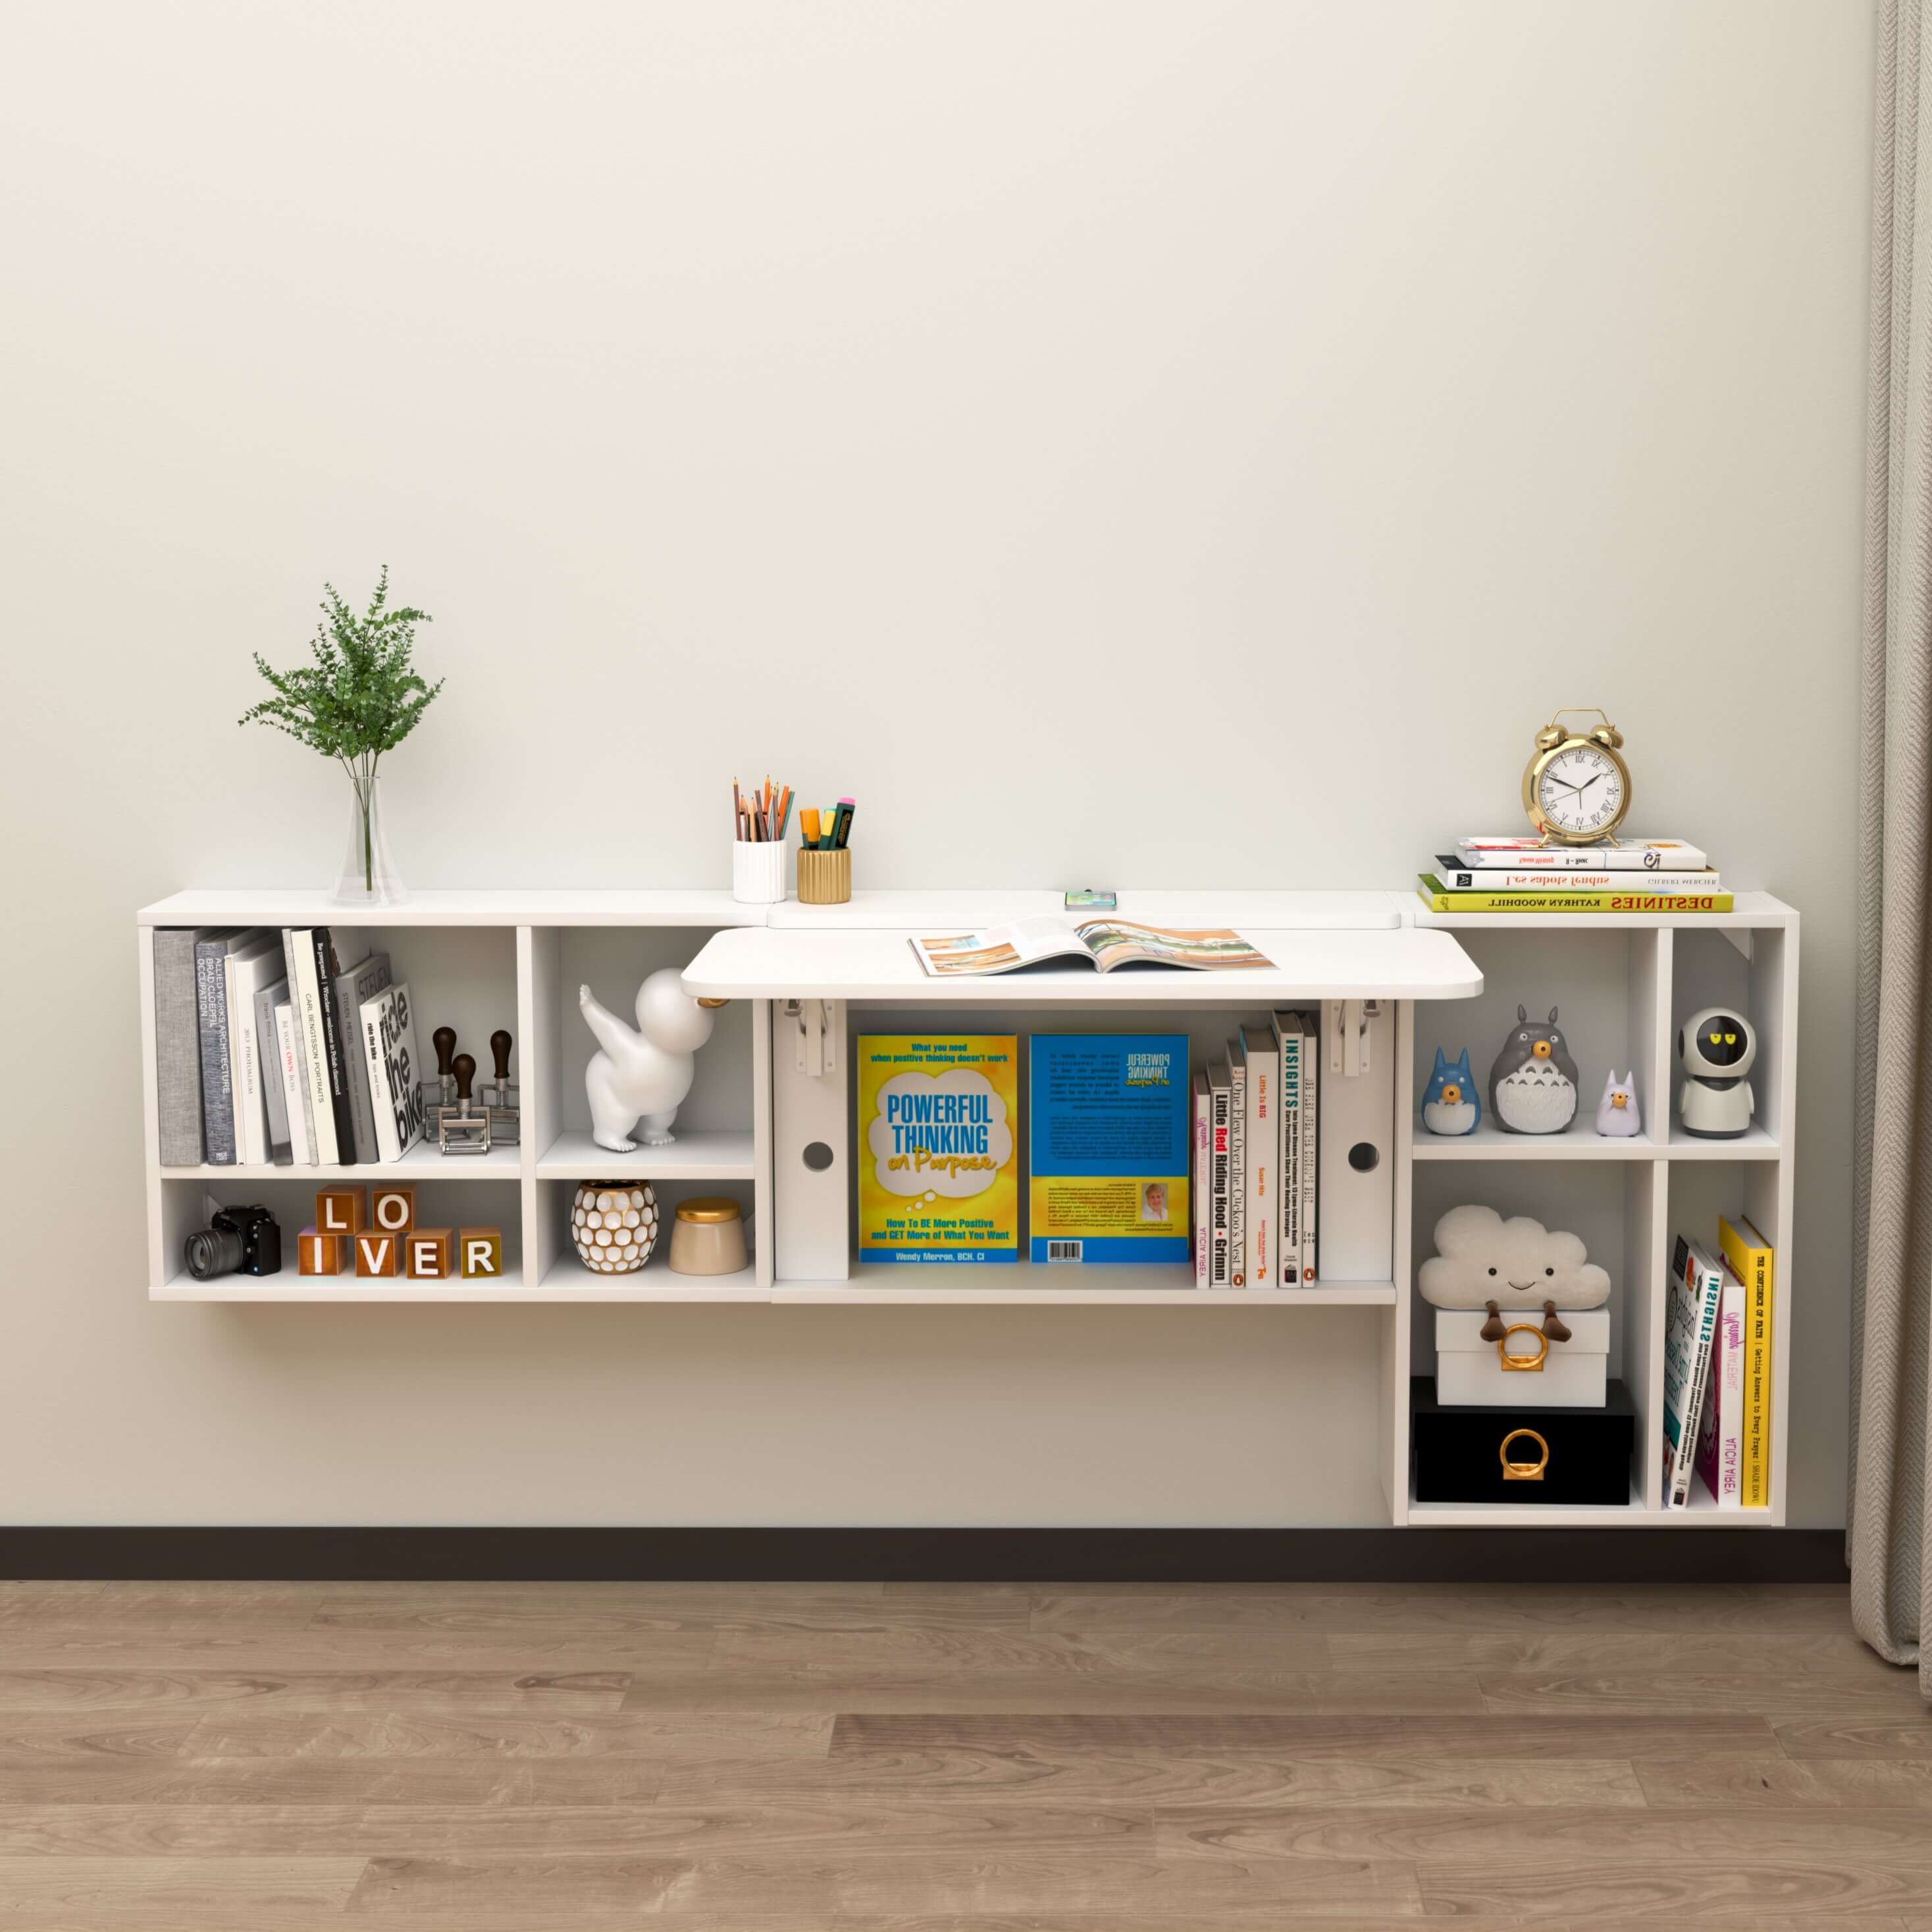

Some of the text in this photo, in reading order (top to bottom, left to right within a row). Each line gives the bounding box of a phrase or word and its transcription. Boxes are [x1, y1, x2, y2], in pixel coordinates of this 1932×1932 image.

[206, 958, 215, 983] BRAD
[215, 958, 224, 989] ALLIED
[197, 958, 207, 1017] OCCUPATION
[219, 1025, 230, 1094] ARCHITECTURE
[308, 1014, 319, 1058] BENGTSSON
[314, 1062, 324, 1103] PORTRAITS
[893, 1055, 923, 1063] positive
[926, 1055, 955, 1063] thinking
[933, 1044, 947, 1053] you
[1285, 1039, 1299, 1107] INSIGHTS
[1233, 1083, 1243, 1105] One
[887, 1095, 993, 1123] POWERFUL
[1233, 1109, 1243, 1135] Flew
[892, 1125, 988, 1153] THINKING
[1232, 1139, 1243, 1164] Over
[888, 1145, 997, 1178] on Purpose
[1214, 1095, 1228, 1229] Little Red Riding Hood
[1232, 1168, 1243, 1184] the
[887, 1219, 993, 1228] How To BE More Positive
[1232, 1189, 1243, 1237] Cuckoo's
[872, 1231, 1009, 1240] and GET More of What You Want
[896, 1253, 921, 1262] Wendy
[1214, 1238, 1228, 1280] Grimm
[1232, 1241, 1243, 1263] Nest
[1754, 1348, 1762, 1374] Getting
[1752, 1416, 1761, 1434] Every
[1751, 1438, 1760, 1459] Prayer
